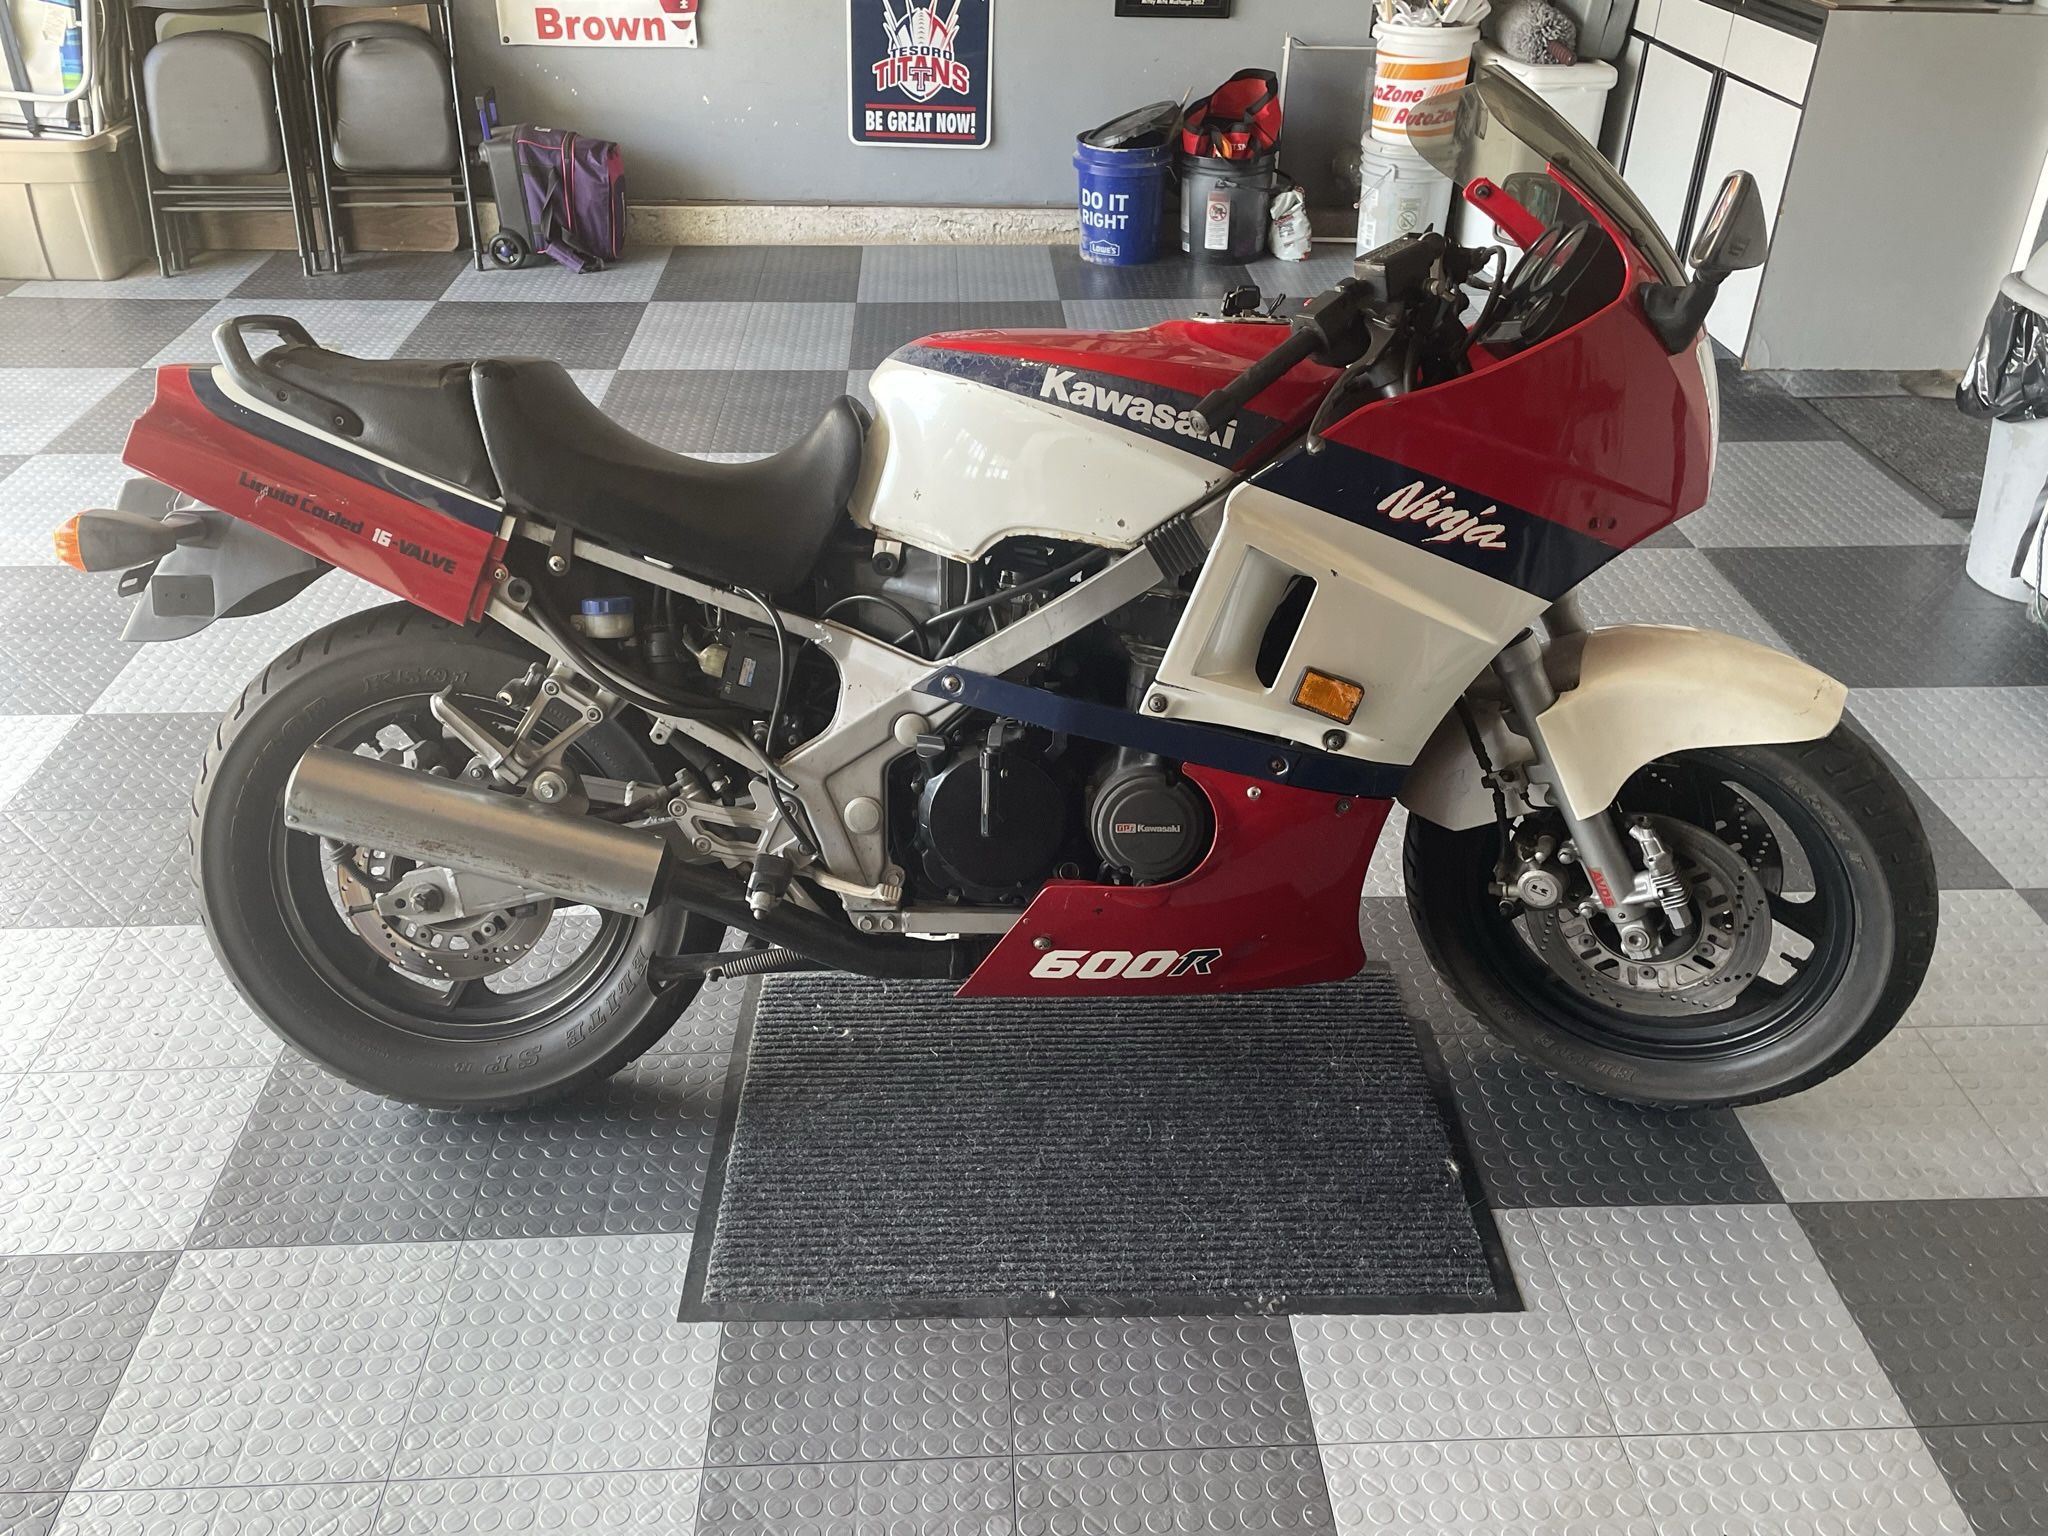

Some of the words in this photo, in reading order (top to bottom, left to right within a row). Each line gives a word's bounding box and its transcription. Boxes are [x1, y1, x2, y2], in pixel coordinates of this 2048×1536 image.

[535, 7, 666, 41] Brown
[890, 45, 953, 60] TESORO
[873, 55, 970, 94] TITANS
[865, 110, 883, 131] BE
[887, 111, 932, 132] GREAT
[936, 112, 976, 134] NOW!
[1081, 187, 1103, 207] DO
[1108, 194, 1129, 212] IT
[1082, 209, 1129, 230] RIGHT
[300, 497, 364, 534] Cooled
[1376, 480, 1507, 549] Ninja
[1137, 824, 1181, 832] Kawasaki
[1029, 947, 1223, 979] 600R
[566, 945, 650, 1050] ELITE
[482, 1045, 543, 1075] SP
